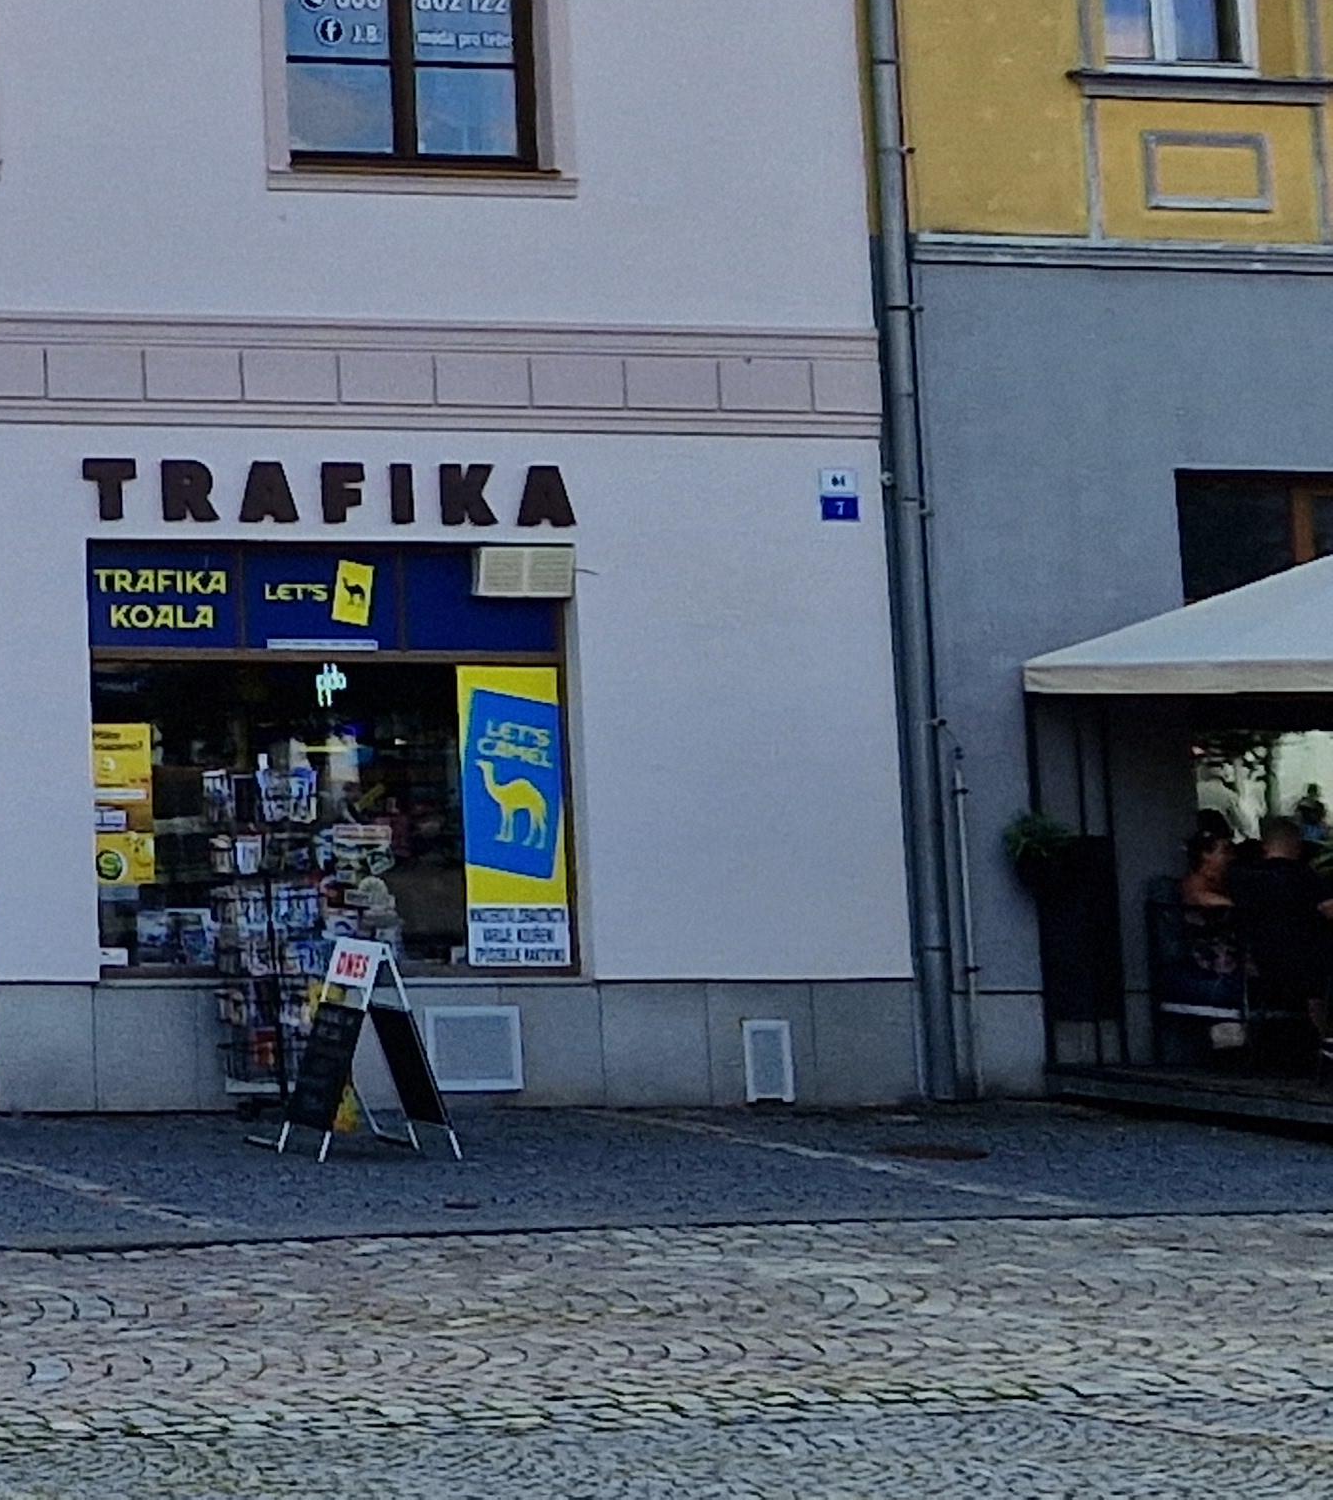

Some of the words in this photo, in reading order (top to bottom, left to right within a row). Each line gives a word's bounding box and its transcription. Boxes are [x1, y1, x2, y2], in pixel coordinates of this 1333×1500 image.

[82, 458, 577, 527] TRAFIKA
[93, 568, 227, 595] TRAFIKA
[264, 582, 328, 602] LET'S
[109, 604, 214, 629] KOALA
[485, 718, 551, 748] LET'S
